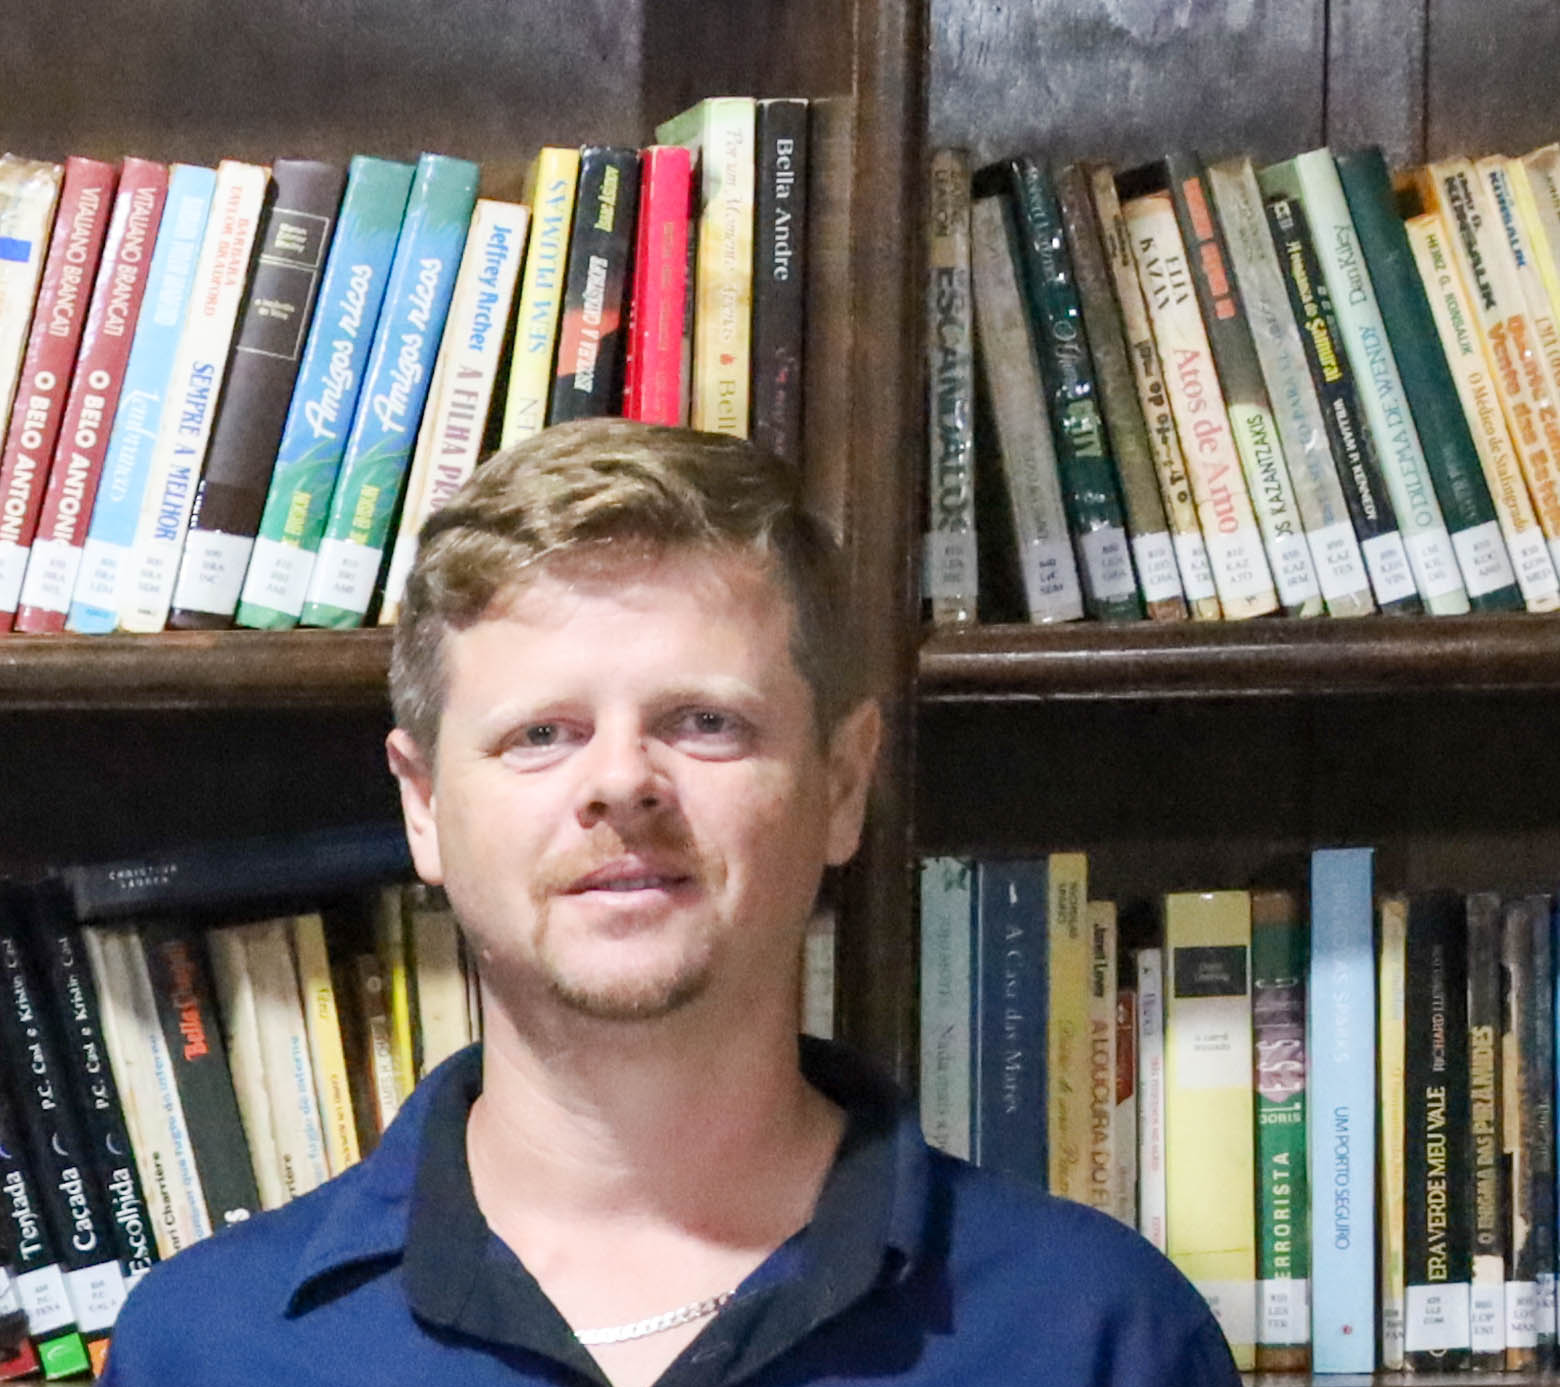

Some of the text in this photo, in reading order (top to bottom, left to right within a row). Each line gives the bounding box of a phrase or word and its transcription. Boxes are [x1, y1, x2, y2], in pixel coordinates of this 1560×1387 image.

[46, 184, 101, 338] VITALIANO BRANCATI
[102, 184, 155, 336] VITALIANO BRANCATI
[526, 178, 568, 354] SEM PLUMAS
[770, 137, 795, 280] Bella Andre
[298, 260, 376, 442] Amigos ricos
[367, 254, 444, 437] Amigos ricos
[464, 224, 513, 353] Jeffrey Archer
[1423, 232, 1474, 356] HEINZ KONSALIK
[17, 393, 49, 450] BELO
[72, 393, 104, 449] BELO
[153, 360, 216, 542] SEMPRE MELHOR
[440, 386, 479, 459] FILHA
[1171, 343, 1226, 456] Atos de
[1329, 396, 1378, 521] WILLIAM KENNEDY
[1356, 320, 1435, 528] O DILEMA DE WENDY
[1240, 413, 1293, 516] KAZANTZAKIS
[9, 974, 56, 1110] P.C. Kristin
[64, 974, 110, 1109] P.C. Kristin
[172, 1003, 210, 1061] Bella
[1430, 1014, 1445, 1070] RICHARD
[1088, 1038, 1109, 1183] LOUCURA DO
[0, 1169, 47, 1260] Tentada
[55, 1164, 101, 1253] Caçada
[106, 1166, 154, 1276] Escolhida
[147, 1151, 177, 1226] Charrière
[1269, 1151, 1295, 1279] ERRORISTA
[1334, 1106, 1350, 1248] UM PORTO SEGURO
[1425, 1085, 1448, 1280] ERA VERDE MEU VALE
